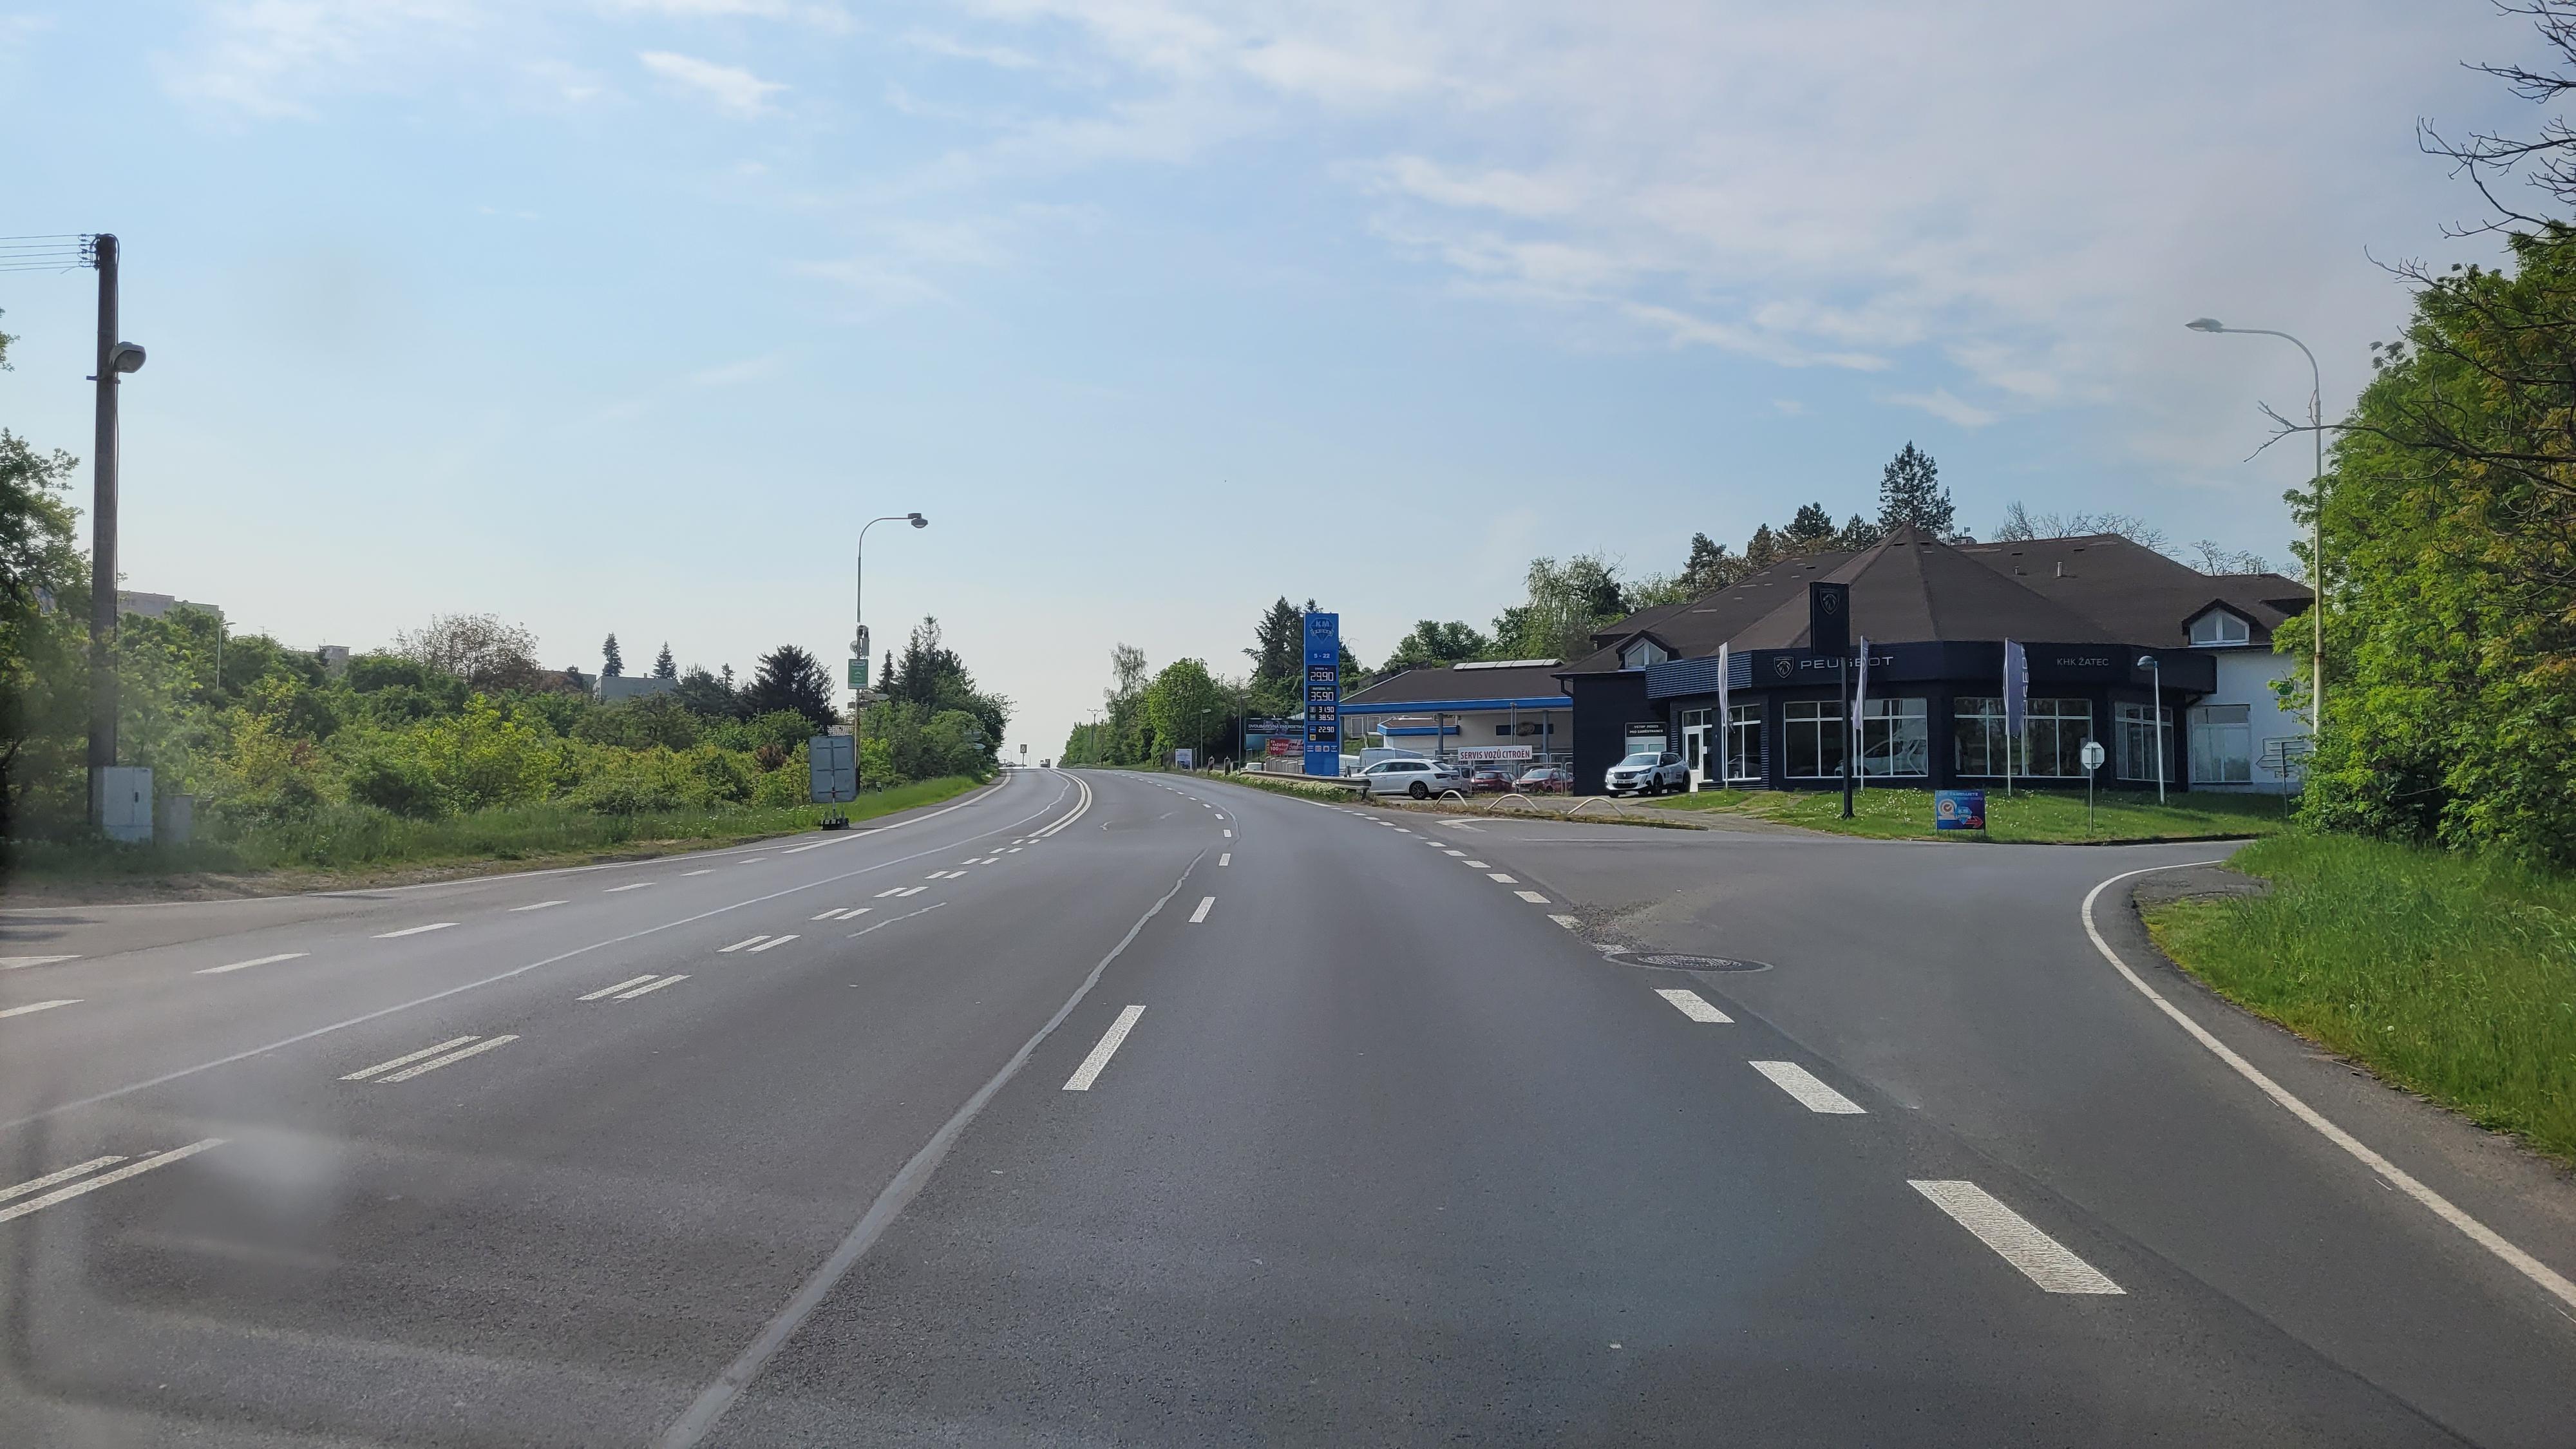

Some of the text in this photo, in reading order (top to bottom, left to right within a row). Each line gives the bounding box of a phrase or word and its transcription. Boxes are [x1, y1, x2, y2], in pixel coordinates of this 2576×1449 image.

[1801, 656, 1894, 669] PEUEOT
[2078, 656, 2109, 666] ŽATEC
[1484, 749, 1501, 759] VOZŮ
[1502, 748, 1530, 759] CITROËN
